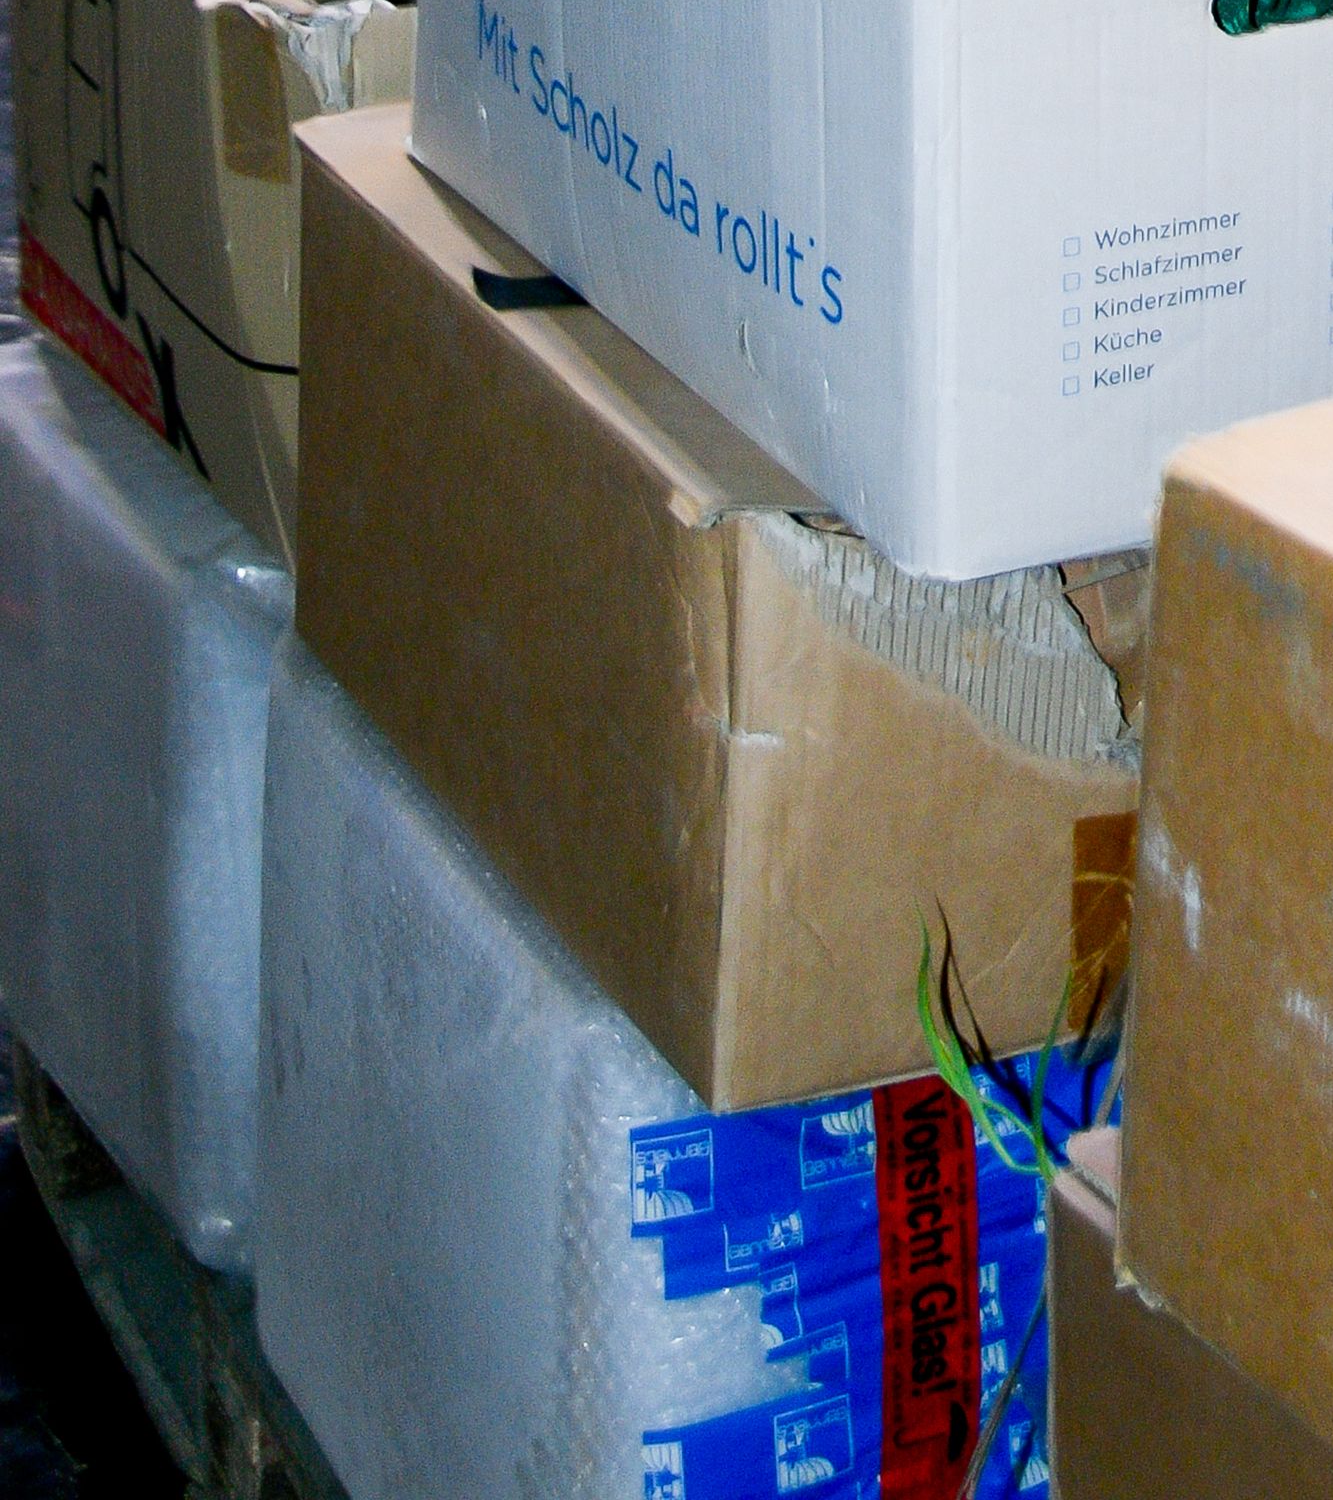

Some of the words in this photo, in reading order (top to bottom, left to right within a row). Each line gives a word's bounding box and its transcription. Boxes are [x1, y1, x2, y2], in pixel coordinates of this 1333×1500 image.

[530, 44, 643, 193] Scholz
[653, 147, 700, 237] da
[1094, 211, 1241, 250] Wohnzimmer
[1094, 245, 1243, 285] Schlafzimmer
[1094, 278, 1247, 320] Kinderzimmer
[1094, 327, 1163, 355] Küche
[1093, 362, 1155, 389] Keller
[901, 1089, 953, 1274] Vorsicht
[909, 1281, 958, 1398] Glas!
